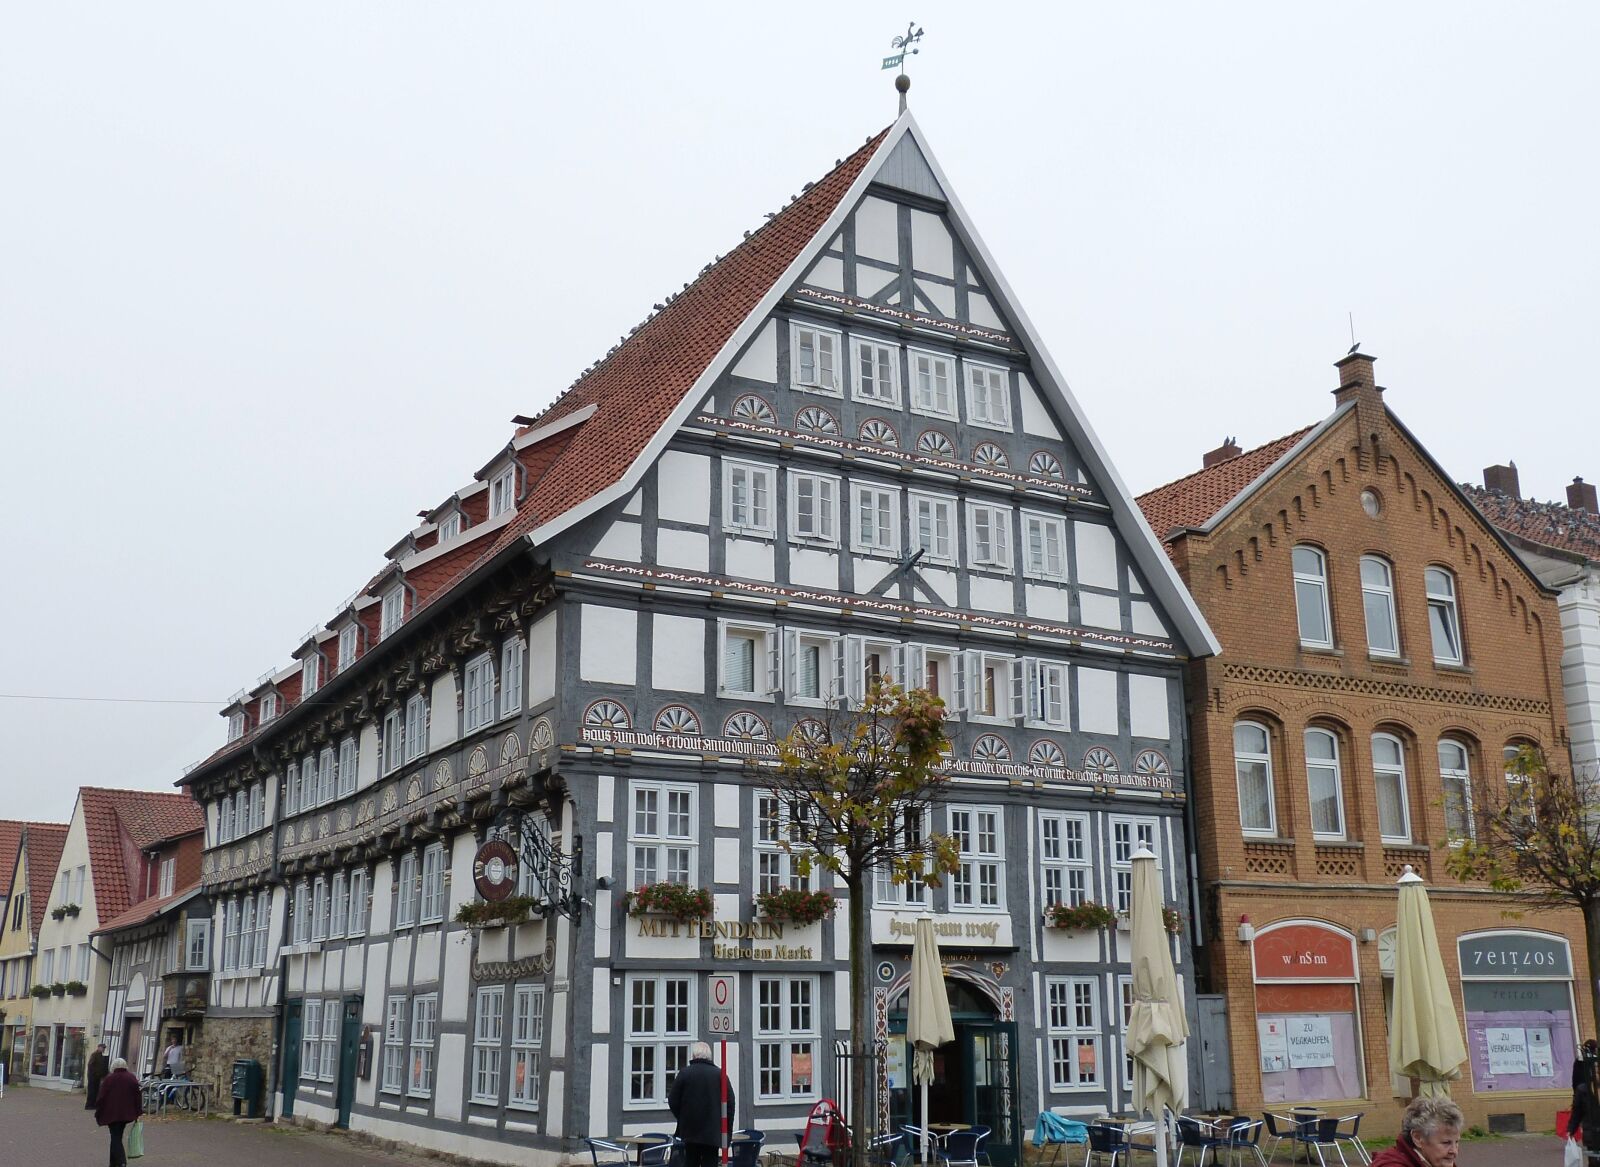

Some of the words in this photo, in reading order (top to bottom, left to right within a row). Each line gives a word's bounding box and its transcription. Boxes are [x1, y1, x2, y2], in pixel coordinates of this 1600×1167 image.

[612, 731, 636, 745] zum
[666, 734, 702, 751] erbaut
[638, 917, 784, 940] MITTENDRIN
[933, 922, 962, 937] zum
[713, 943, 752, 959] Bistro
[754, 948, 772, 960] am
[774, 944, 813, 960] Markt
[1303, 1023, 1313, 1032] ZU
[1290, 1036, 1330, 1045] VERKAUFEN
[1501, 1032, 1510, 1041] ZU
[1490, 1044, 1524, 1053] VERKAUFEN
